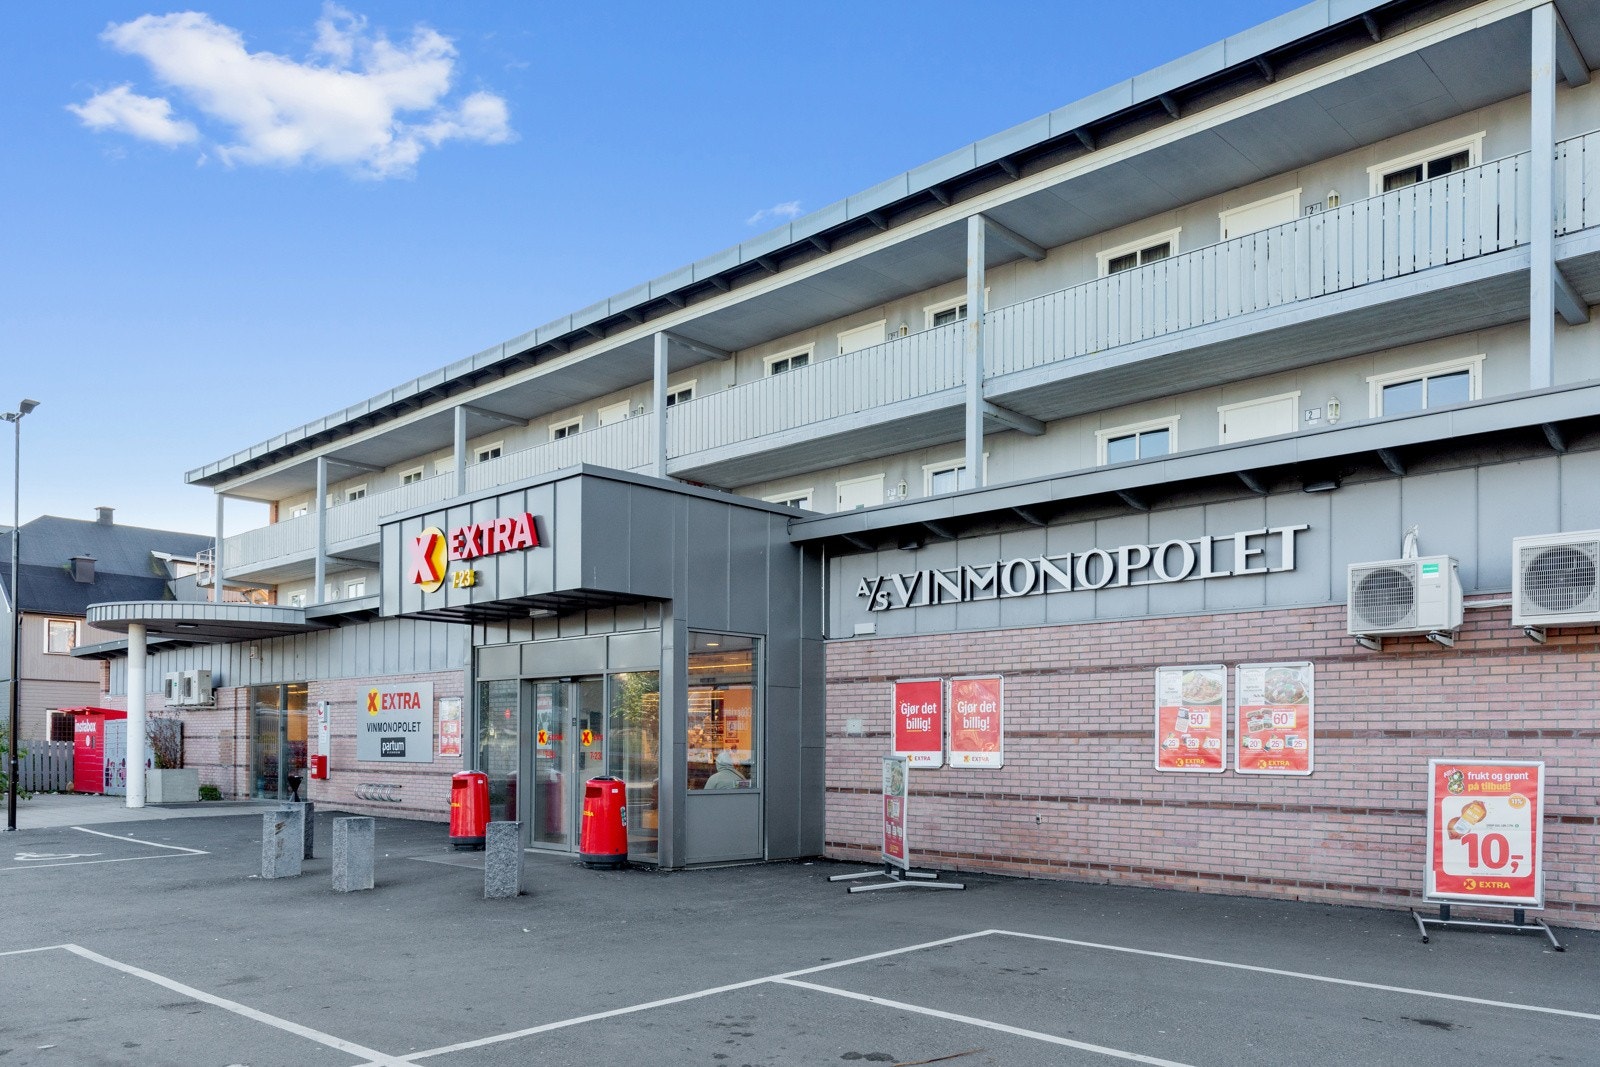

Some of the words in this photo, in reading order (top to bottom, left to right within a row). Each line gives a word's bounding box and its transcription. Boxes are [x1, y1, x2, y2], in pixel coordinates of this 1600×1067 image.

[447, 512, 540, 561] EXTRA
[889, 524, 1310, 609] VINMONOPOLET
[382, 692, 421, 710] EXTRA
[901, 703, 920, 717] Gjør
[921, 703, 937, 714] det
[957, 701, 978, 716] Gjør
[980, 701, 997, 713] det
[906, 717, 931, 731] billig!
[963, 716, 990, 731] billig!
[1190, 713, 1204, 725] 50
[1273, 713, 1288, 725] 60
[366, 722, 421, 733] VINMONOPOLET
[382, 740, 405, 754] partum
[1467, 772, 1490, 780] frukt
[1492, 774, 1503, 782] og
[1504, 772, 1529, 783] grønt
[1467, 782, 1480, 792] på
[1481, 782, 1511, 791] tilbud!
[1461, 833, 1524, 874] 10,-
[1479, 881, 1511, 889] EXTRA
